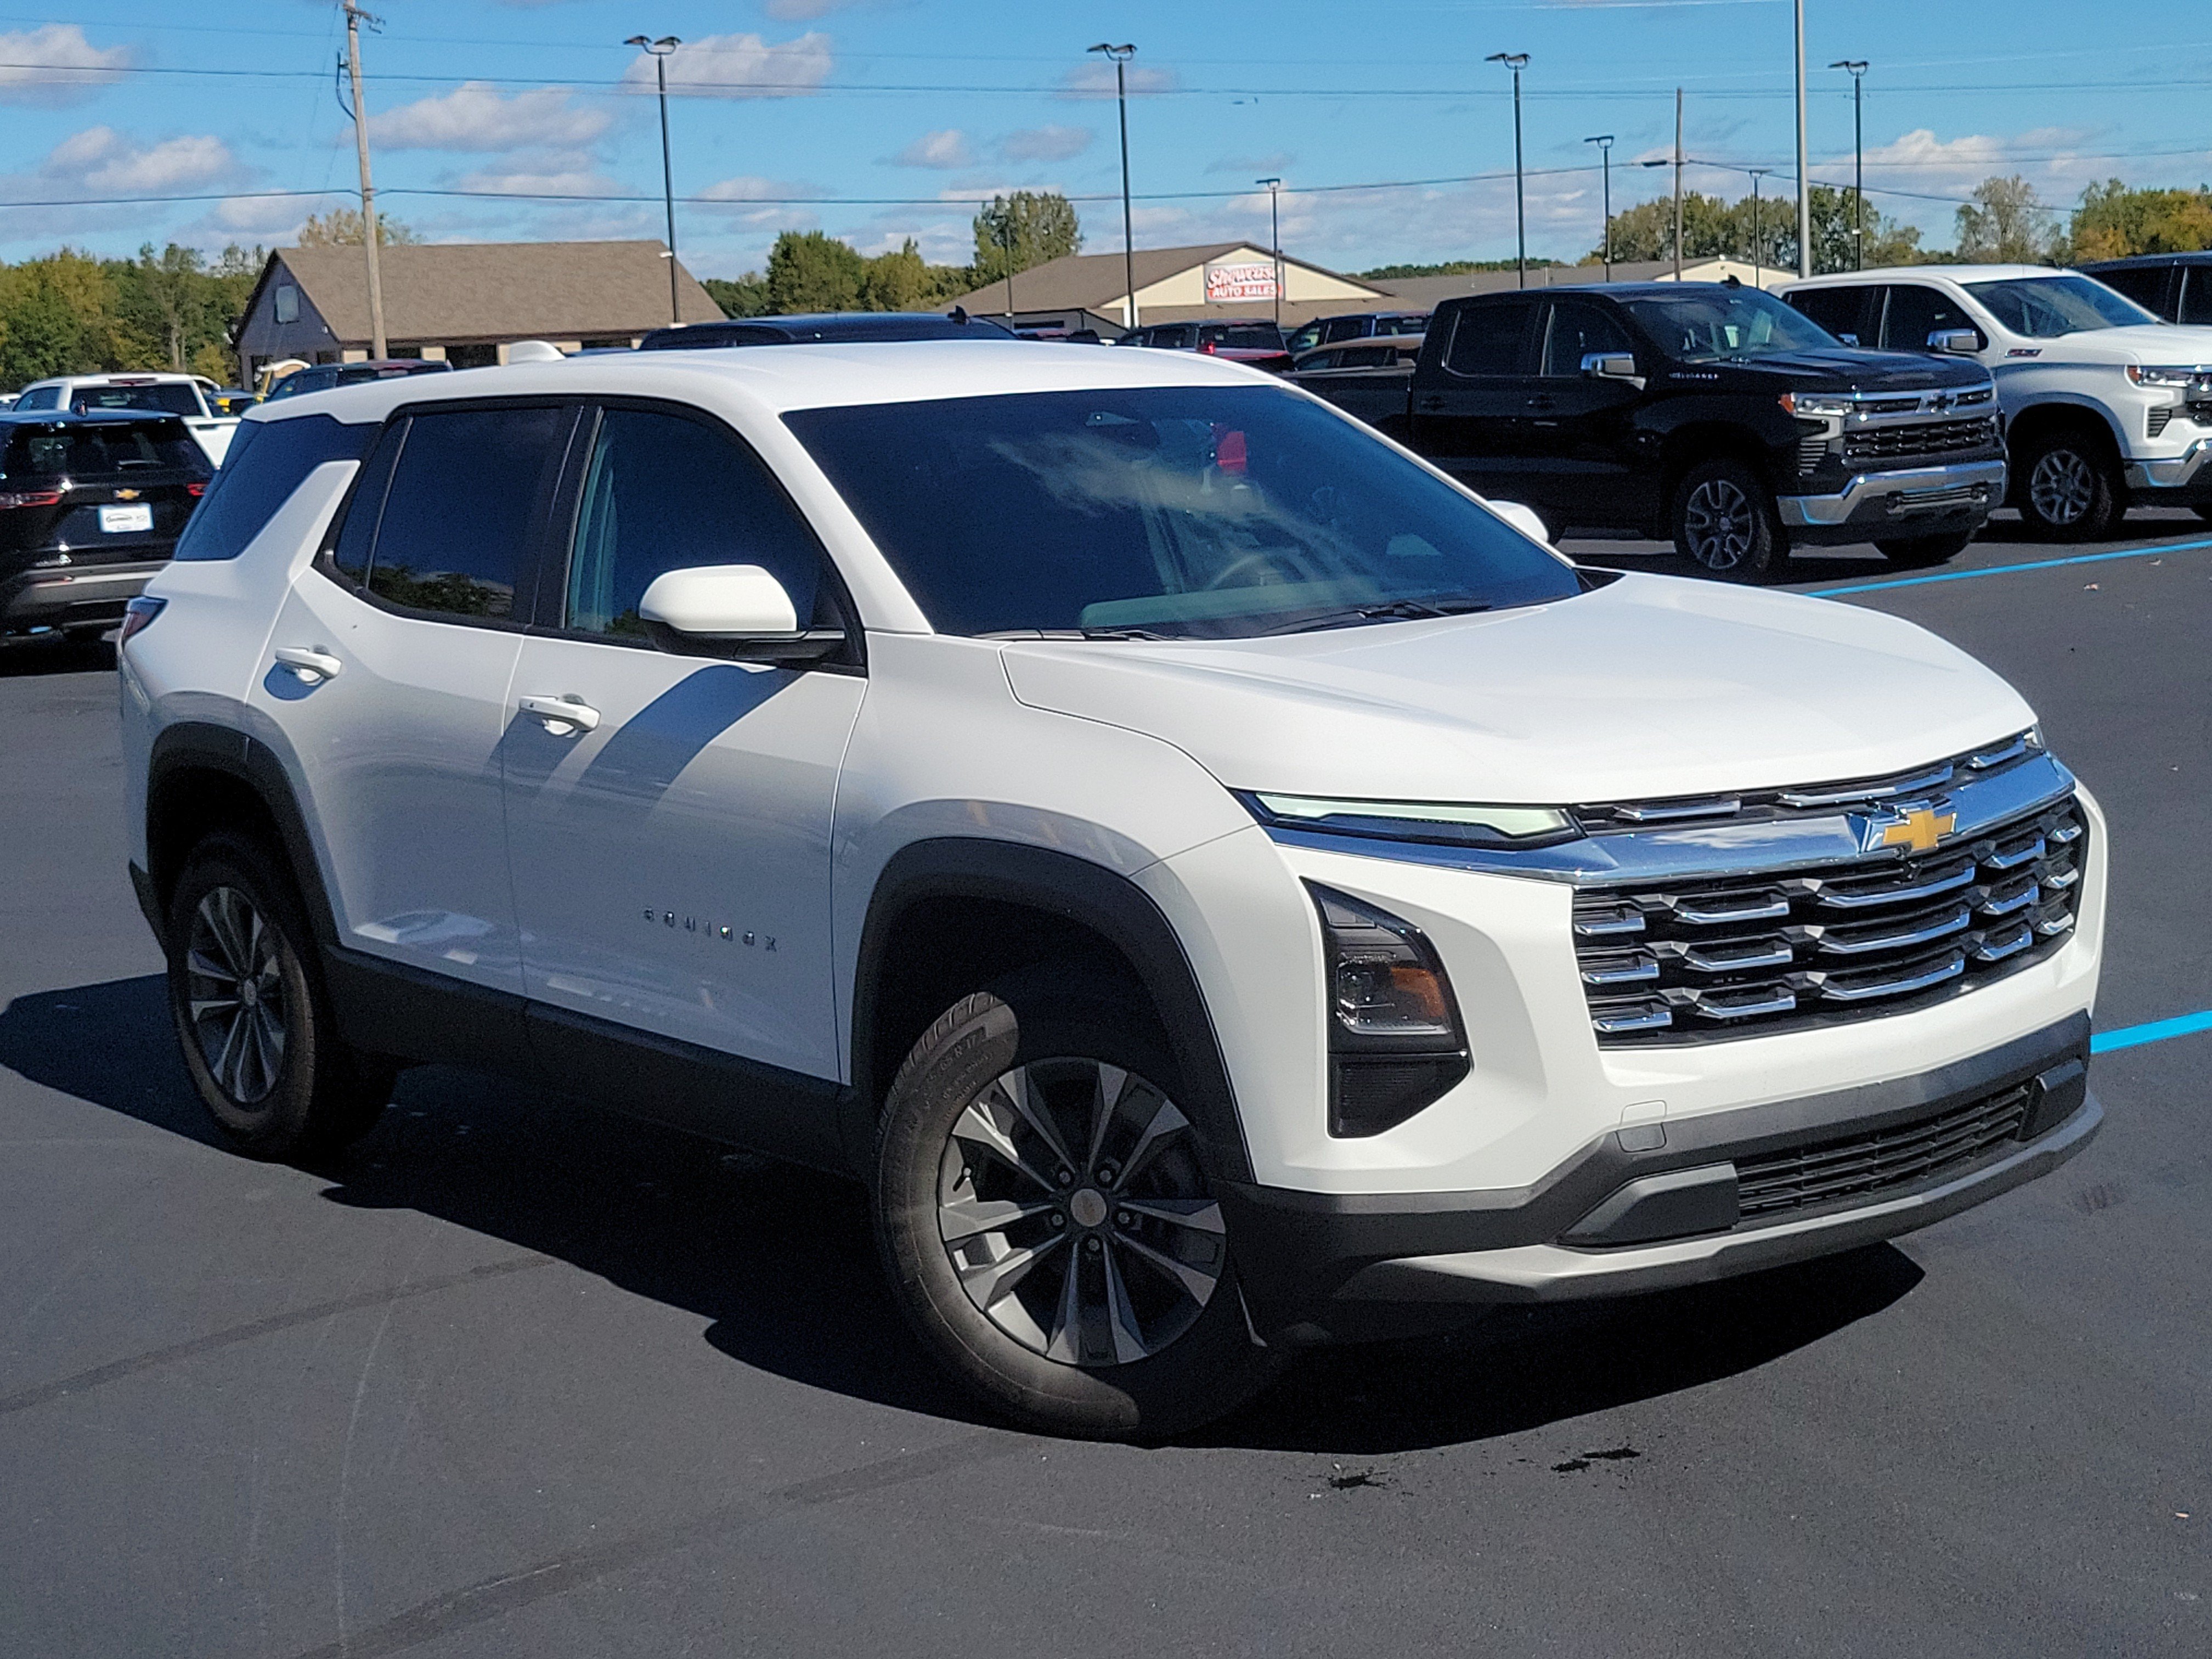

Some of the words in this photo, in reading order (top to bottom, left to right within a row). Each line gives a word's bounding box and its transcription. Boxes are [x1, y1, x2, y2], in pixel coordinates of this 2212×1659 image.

[1213, 286, 1242, 297] AUTO
[1244, 284, 1276, 296] SALES
[644, 909, 777, 952] EQUINOX
